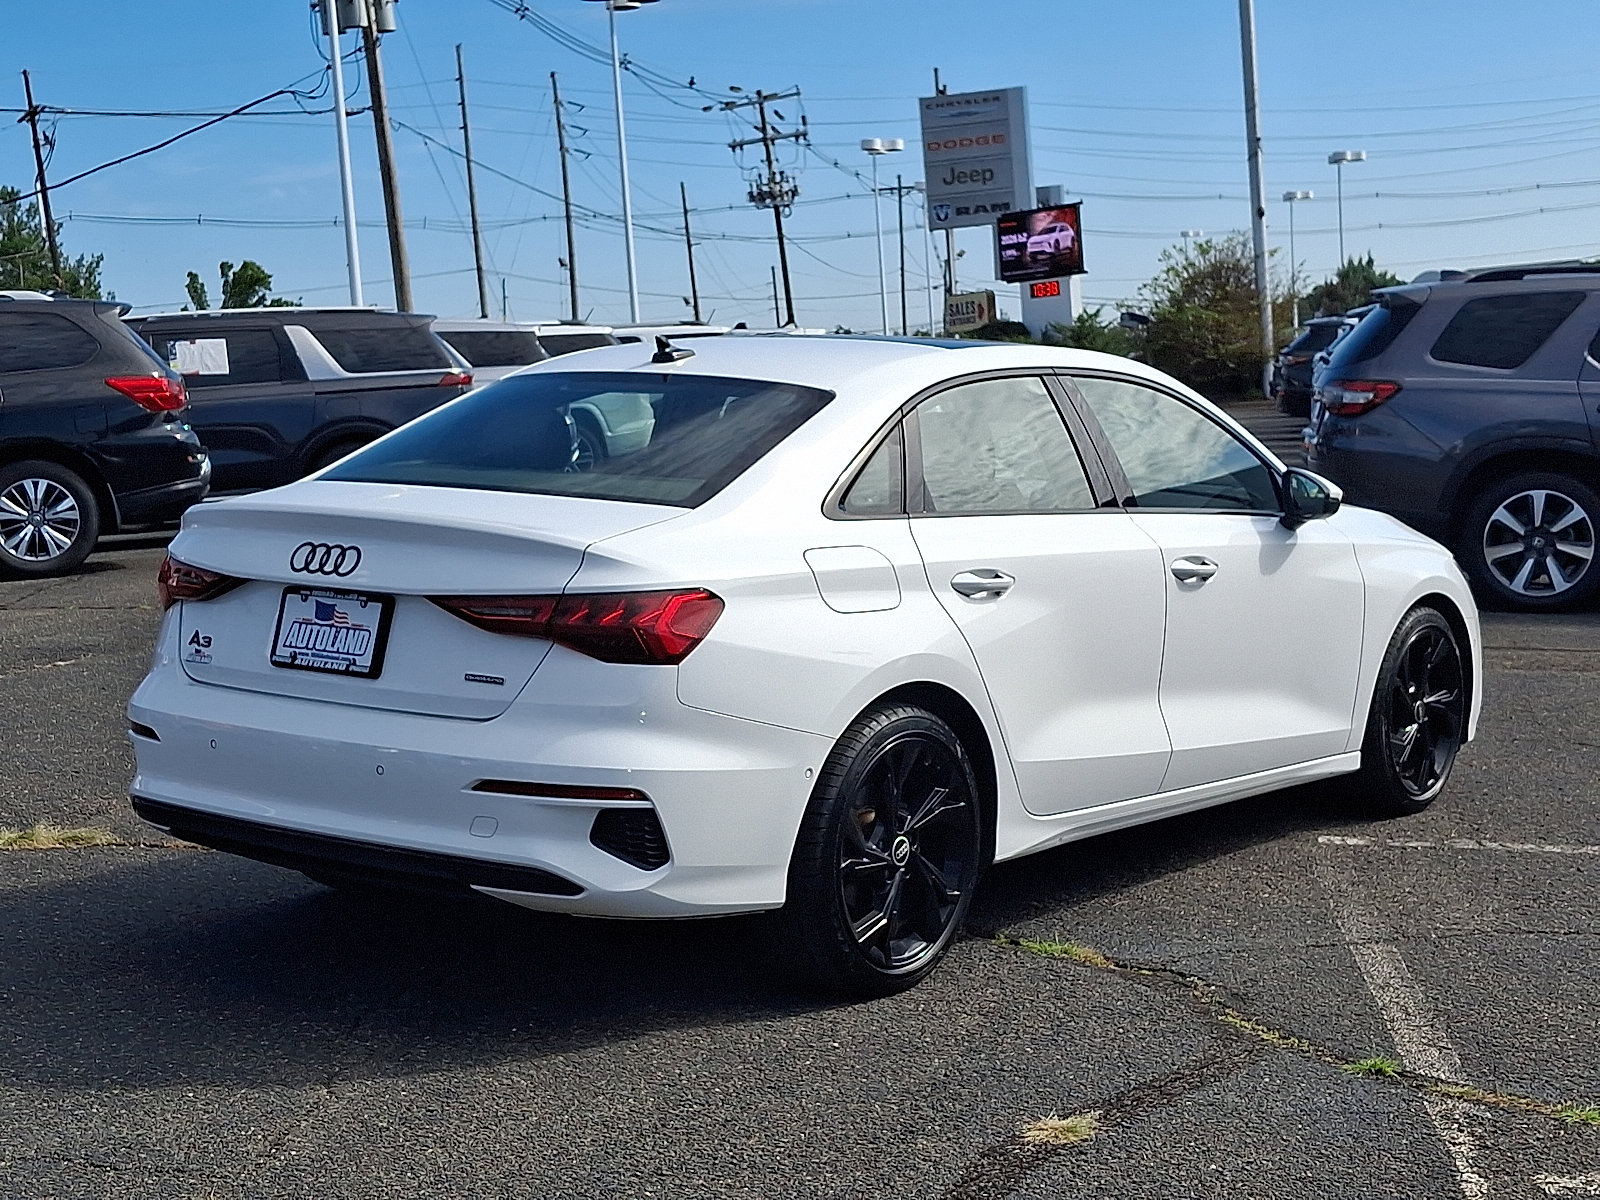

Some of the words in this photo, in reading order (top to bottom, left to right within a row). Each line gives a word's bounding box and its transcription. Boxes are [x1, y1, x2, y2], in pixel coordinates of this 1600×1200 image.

[925, 96, 1001, 110] CHRYSLER
[927, 134, 1006, 152] DODGE
[942, 166, 995, 186] Jeep
[955, 202, 1011, 217] RAM
[949, 300, 976, 318] SALES
[188, 629, 213, 648] A3
[284, 621, 370, 655] AUTOLAND
[293, 657, 348, 671] AUTOLAND
